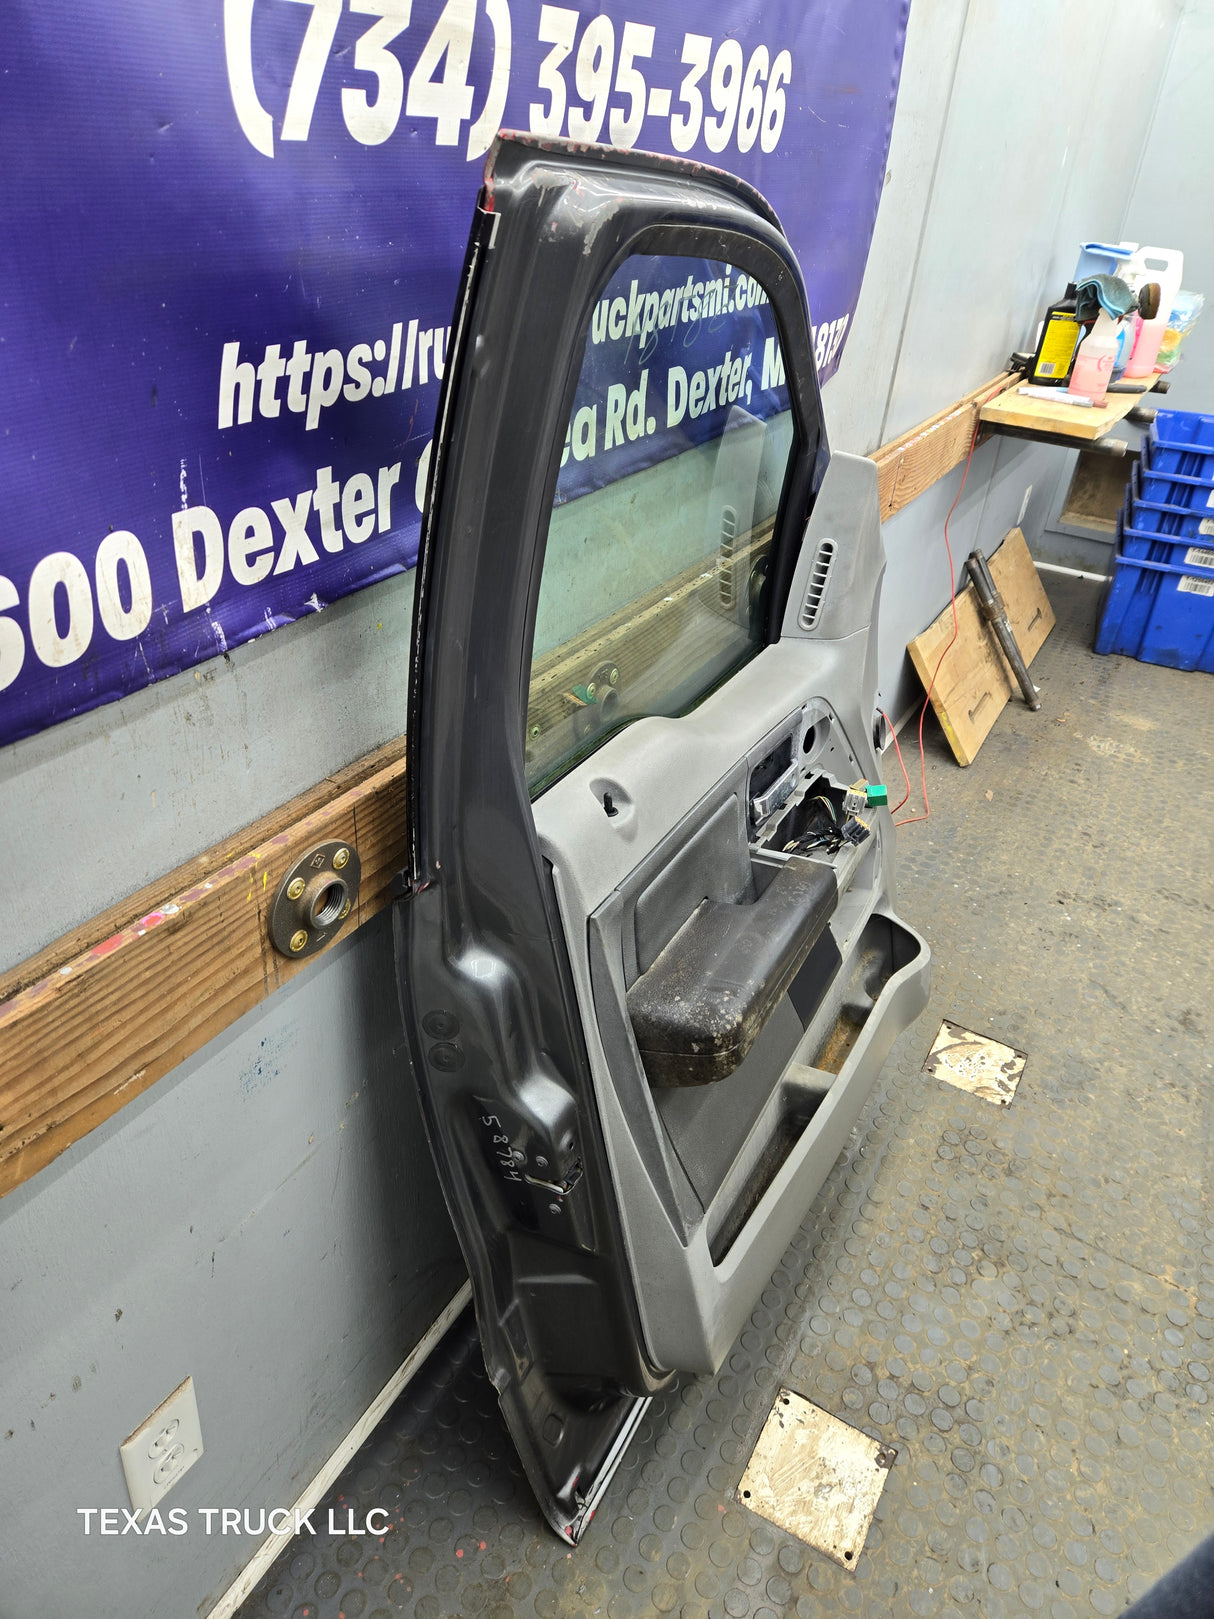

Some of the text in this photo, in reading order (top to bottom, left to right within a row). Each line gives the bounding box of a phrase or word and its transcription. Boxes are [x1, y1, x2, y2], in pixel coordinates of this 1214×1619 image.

[224, 0, 792, 161] (734) 395-3966
[172, 462, 401, 613] Dexter
[604, 369, 656, 450] Rd.
[667, 351, 752, 428] Dexter,
